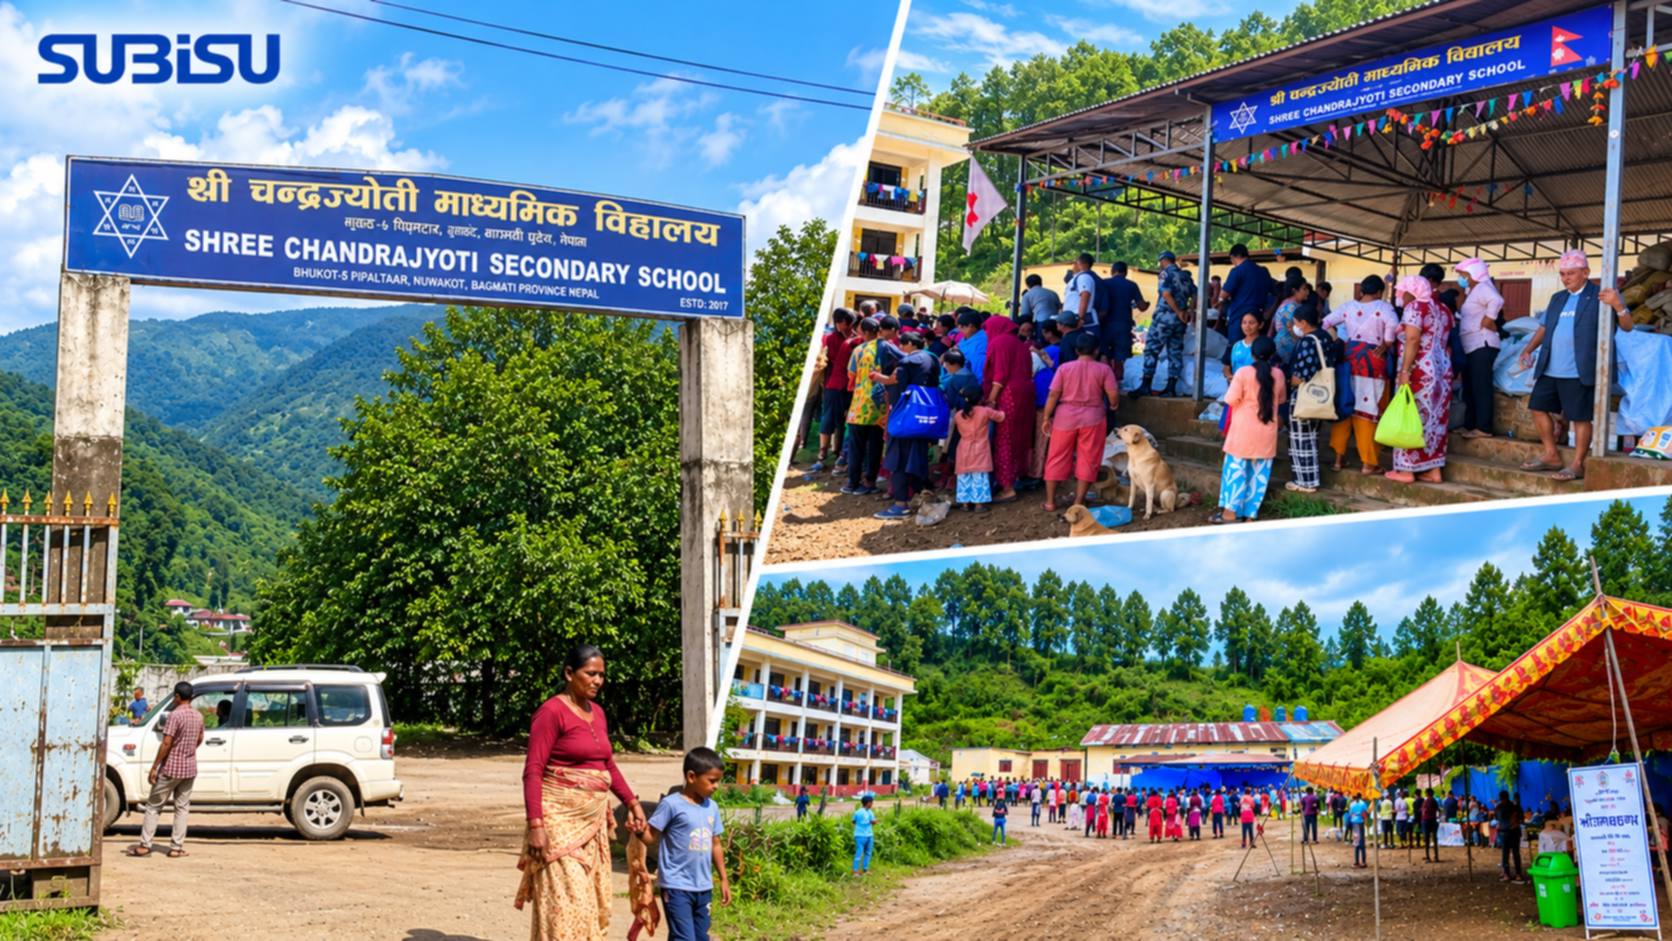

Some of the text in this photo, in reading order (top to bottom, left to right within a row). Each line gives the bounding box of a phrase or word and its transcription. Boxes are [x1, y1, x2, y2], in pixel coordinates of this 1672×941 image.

[1268, 110, 1300, 125] SHREE
[1303, 91, 1386, 117] CHANDRAJYOTI
[1389, 73, 1464, 99] SECONDARY
[1468, 60, 1526, 80] SCHOOL
[187, 168, 232, 203] श्री
[249, 176, 420, 212] चन्द्रज्योती
[434, 190, 579, 227] माध्यमिक
[184, 229, 727, 294] SHREE CHANDRAJYOTI SECONDARY SCHOOL
[293, 267, 600, 299] BHUKOT-5 PIPALTAAR, NUWAKOT, BAGMATI PROVINCE NEPAL
[680, 297, 729, 310] ESTD: 2017
